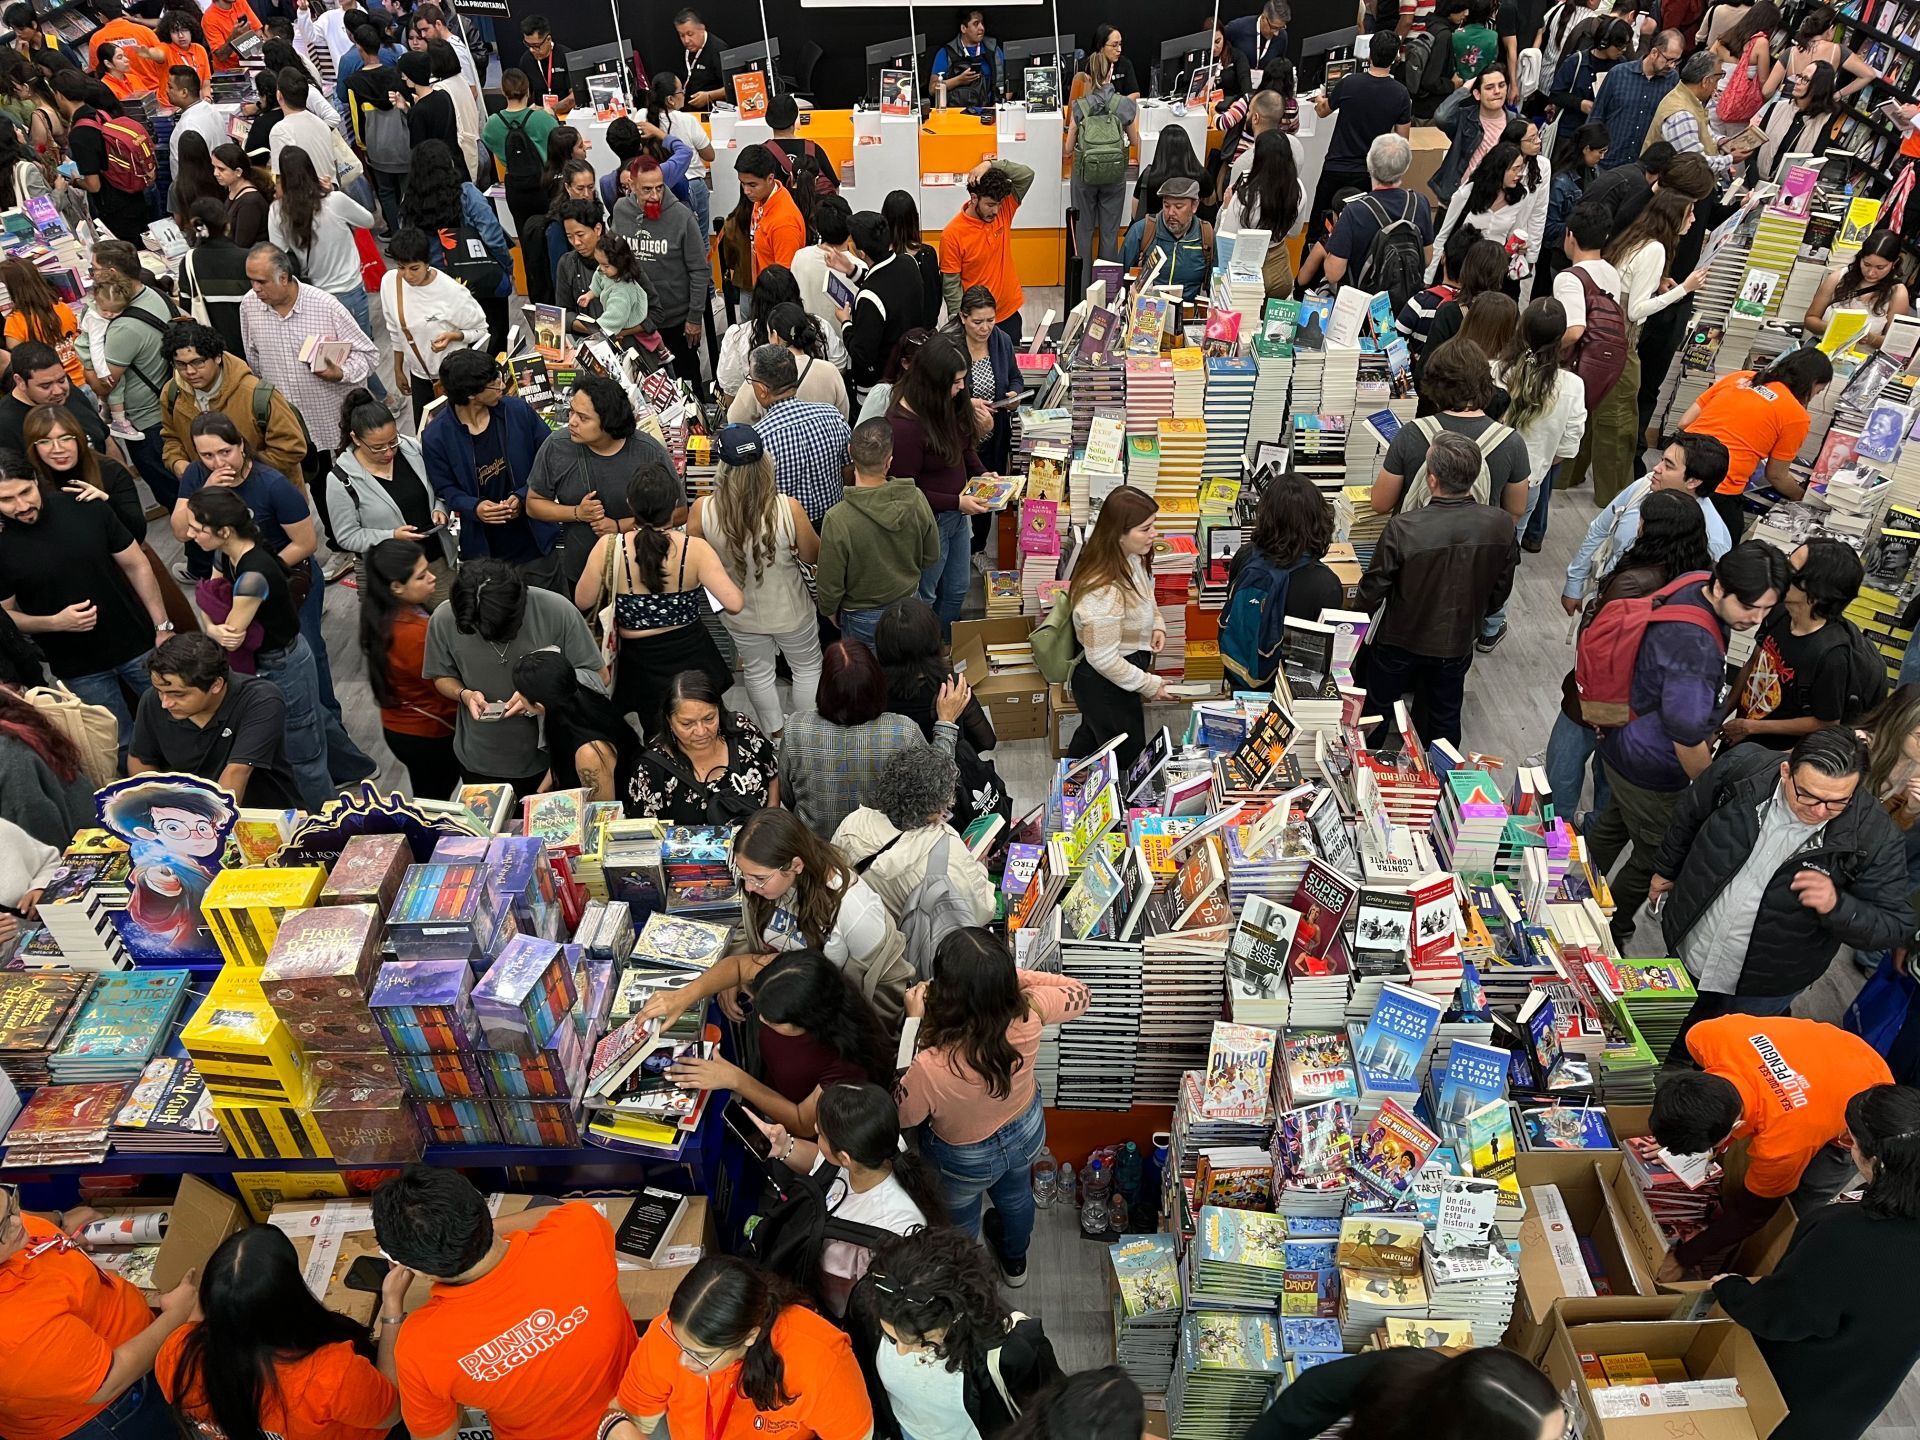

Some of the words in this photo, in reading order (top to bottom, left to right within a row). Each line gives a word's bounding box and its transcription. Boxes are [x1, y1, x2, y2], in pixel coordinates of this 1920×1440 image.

[469, 1, 506, 10] PRIORITARIA
[640, 239, 668, 255] DIEGO
[534, 374, 547, 384] UNA
[518, 384, 542, 397] MENTIRA
[525, 391, 553, 403] PELIGROSA
[1087, 453, 1114, 463] Segovia
[1891, 511, 1905, 519] TAN
[1323, 819, 1342, 847] LICENCIA
[1331, 834, 1341, 847] PARA
[1328, 836, 1349, 866] ROBAR
[1376, 865, 1409, 873] CONTRA
[1307, 872, 1346, 907] SUPER
[1209, 890, 1224, 911] DES
[1304, 881, 1342, 913] VIVIENDO
[1366, 895, 1383, 903] Gritos
[1200, 907, 1217, 924] DE
[300, 928, 353, 941] HARRY
[287, 937, 352, 954] POTTER
[1235, 931, 1277, 958] DENISE
[1232, 941, 1283, 974] DRESSER
[6, 979, 46, 1030] Navidad
[1383, 1006, 1402, 1018] ¿DE
[1405, 1011, 1427, 1025] QUÉ
[1377, 1018, 1390, 1027] LA
[1394, 1021, 1424, 1040] VIDA?
[1378, 1011, 1391, 1020] SE
[1394, 1015, 1427, 1034] TRATA
[79, 1027, 99, 1036] LOS
[1295, 1037, 1311, 1047] LATI
[1312, 1034, 1337, 1045] ALBERTO
[1750, 1035, 1792, 1081] PENGUIN
[1451, 1063, 1465, 1072] SE
[1467, 1067, 1500, 1082] TRATA
[1456, 1058, 1475, 1069] ¿DE
[1478, 1062, 1500, 1074] QUÉ
[172, 1067, 201, 1096] Potte
[1302, 1069, 1346, 1087] BALÓN
[1369, 1070, 1389, 1080] QUÉ
[1451, 1071, 1464, 1080] LA
[1468, 1074, 1499, 1089] VIDA?
[1334, 1081, 1350, 1089] 100
[1766, 1077, 1780, 1089] QUE
[1782, 1080, 1808, 1108] DILO
[156, 1093, 190, 1127] Harry
[1780, 1097, 1793, 1112] SEA
[1213, 1108, 1239, 1117] ALBERTO
[1240, 1108, 1255, 1116] LATI
[343, 1127, 393, 1136] HARRY
[1378, 1113, 1392, 1130] LOS
[1391, 1120, 1432, 1151] MUNDIALES
[336, 1134, 397, 1147] POTTER
[1215, 1171, 1232, 1180] 100
[1233, 1168, 1264, 1177] GLORIAS
[1297, 1174, 1322, 1185] ALBERTO
[1322, 1172, 1336, 1182] LATI
[1355, 1161, 1380, 1183] ALBERTO
[1421, 1169, 1443, 1180] WTF
[1414, 1183, 1441, 1193] TARJE
[1446, 1196, 1456, 1204] Un
[1459, 1197, 1472, 1206] día
[1444, 1211, 1462, 1220] esta
[1445, 1204, 1476, 1215] contaré
[1443, 1217, 1474, 1229] historia
[1381, 1252, 1414, 1262] MARCIANAS
[1284, 1280, 1317, 1292] DANDY
[457, 1308, 556, 1376] PUNTO
[481, 1305, 589, 1382] SEGUIMOS
[1605, 1355, 1645, 1364] CHIMAMANDA
